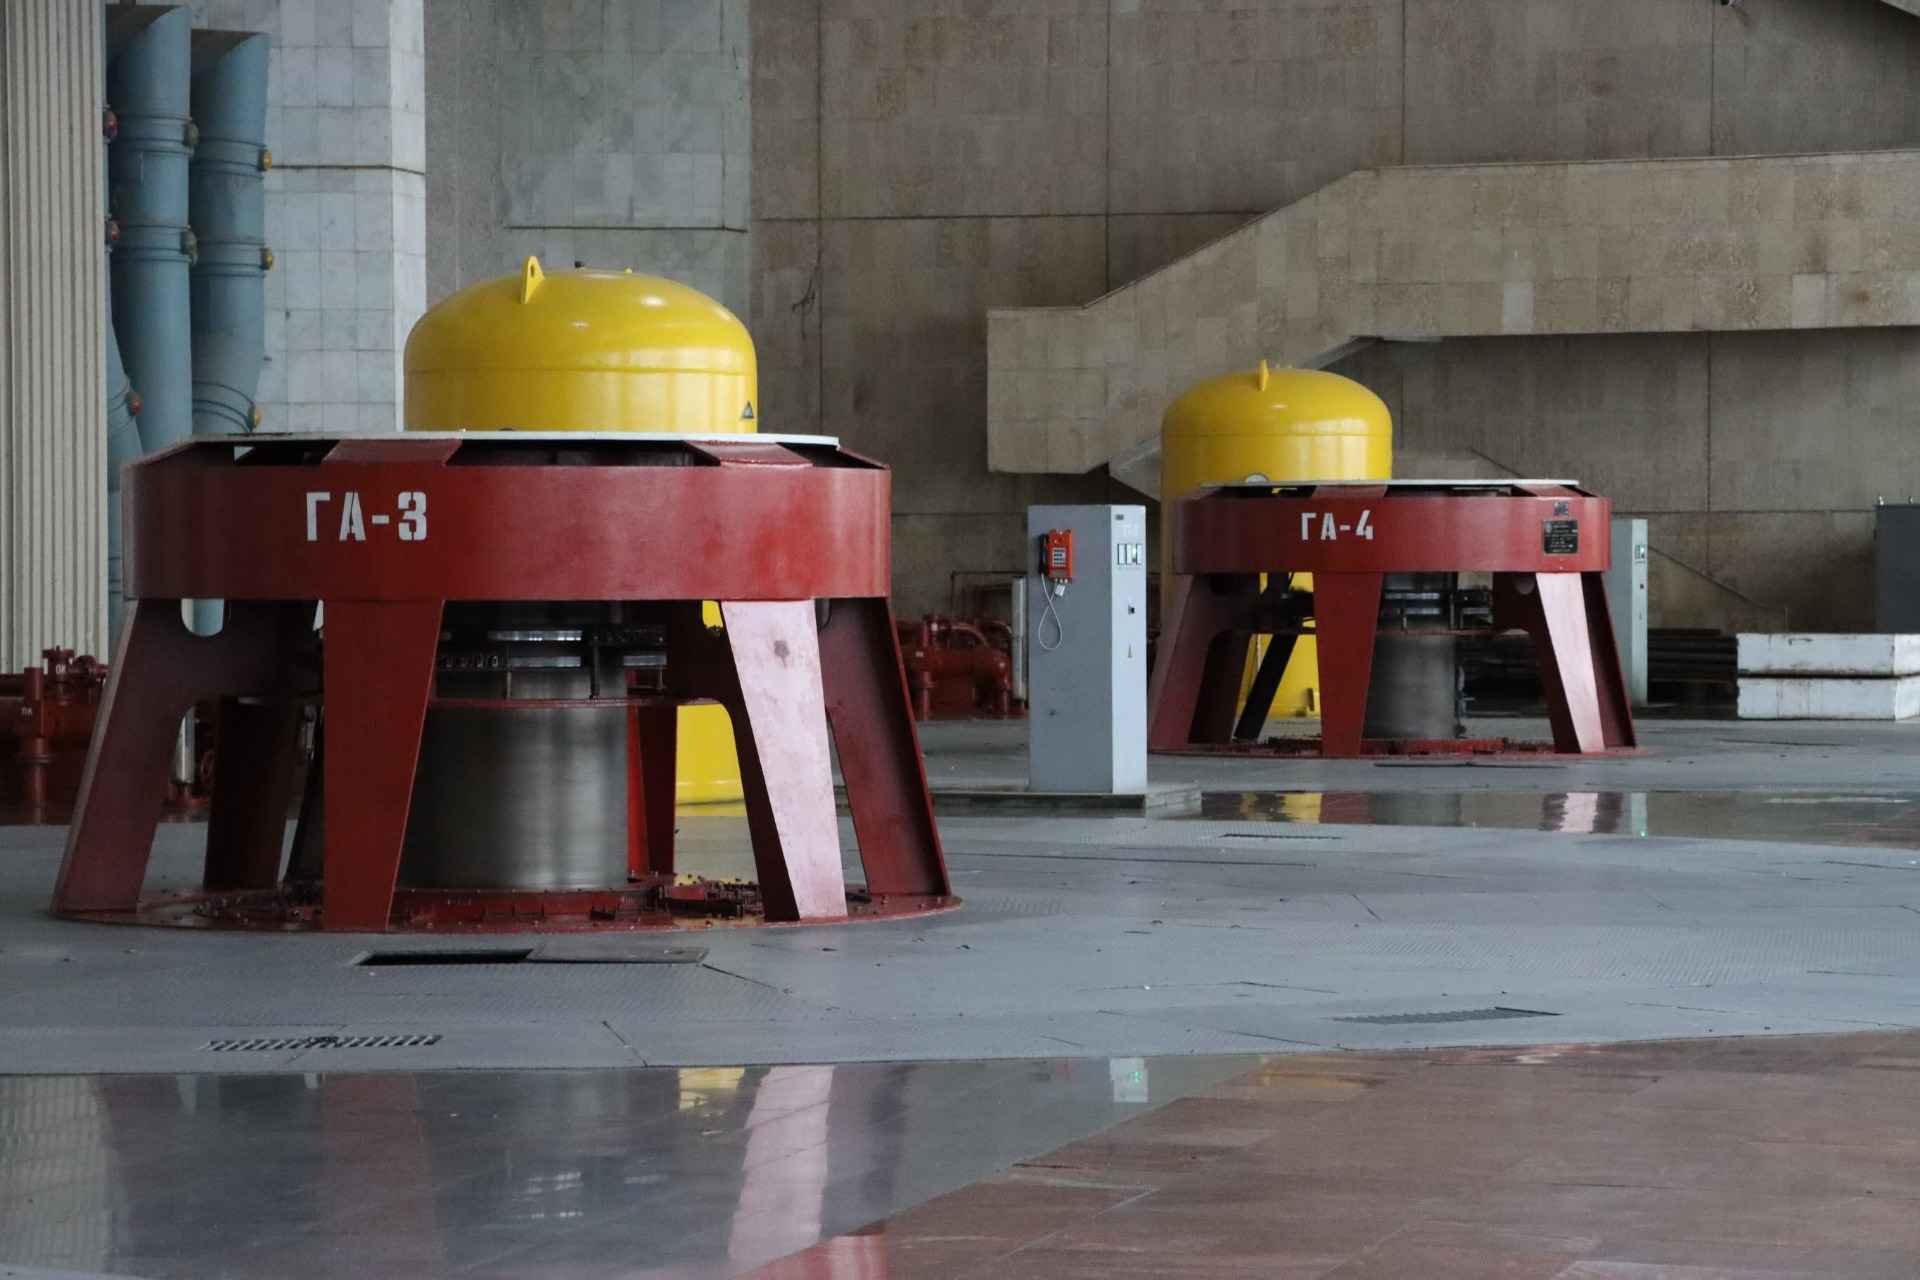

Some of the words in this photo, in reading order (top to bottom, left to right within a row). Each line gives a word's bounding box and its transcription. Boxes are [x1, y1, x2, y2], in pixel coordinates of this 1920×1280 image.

[306, 491, 428, 541] ГА-3
[1300, 509, 1374, 541] ГА-4
[55, 663, 67, 675] ОК
